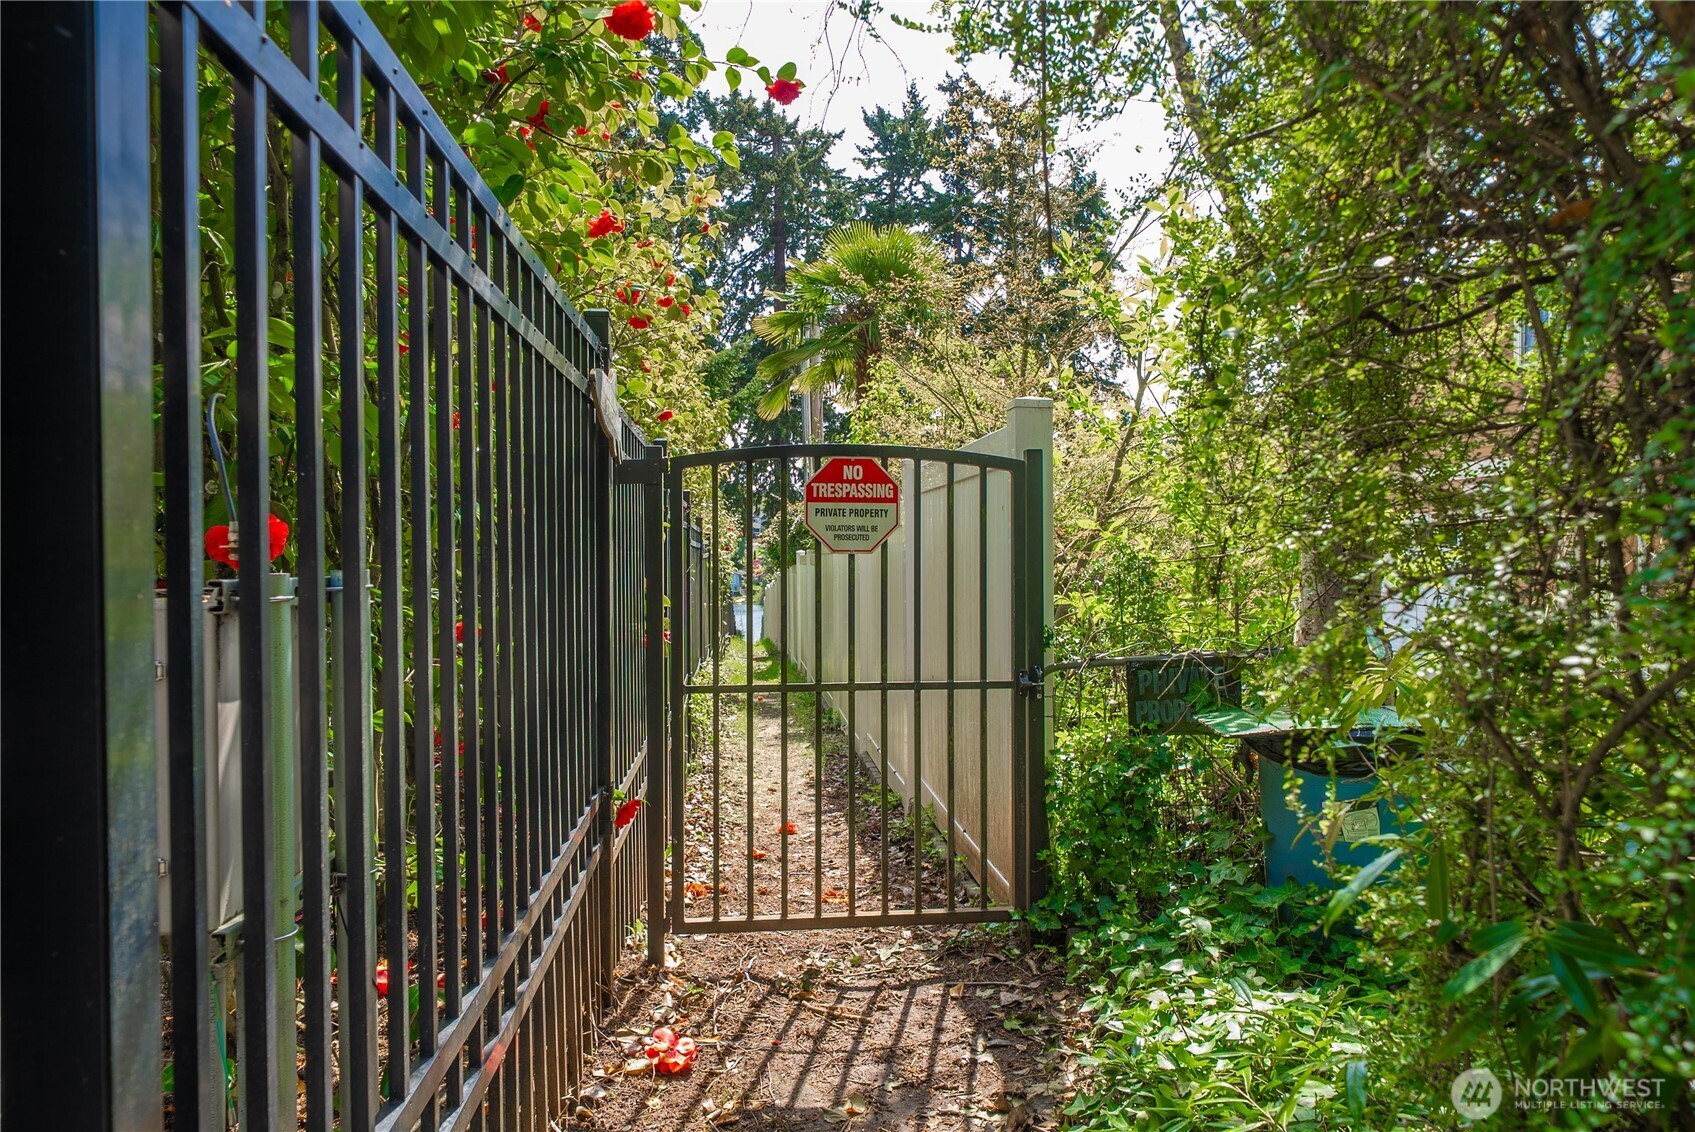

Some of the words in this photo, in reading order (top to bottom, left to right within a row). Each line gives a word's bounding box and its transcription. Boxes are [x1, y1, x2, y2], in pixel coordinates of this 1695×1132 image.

[843, 465, 863, 480] NO
[811, 483, 893, 498] TRESPASSING
[815, 508, 846, 517] PRIVATE
[849, 508, 889, 518] PROPERTY
